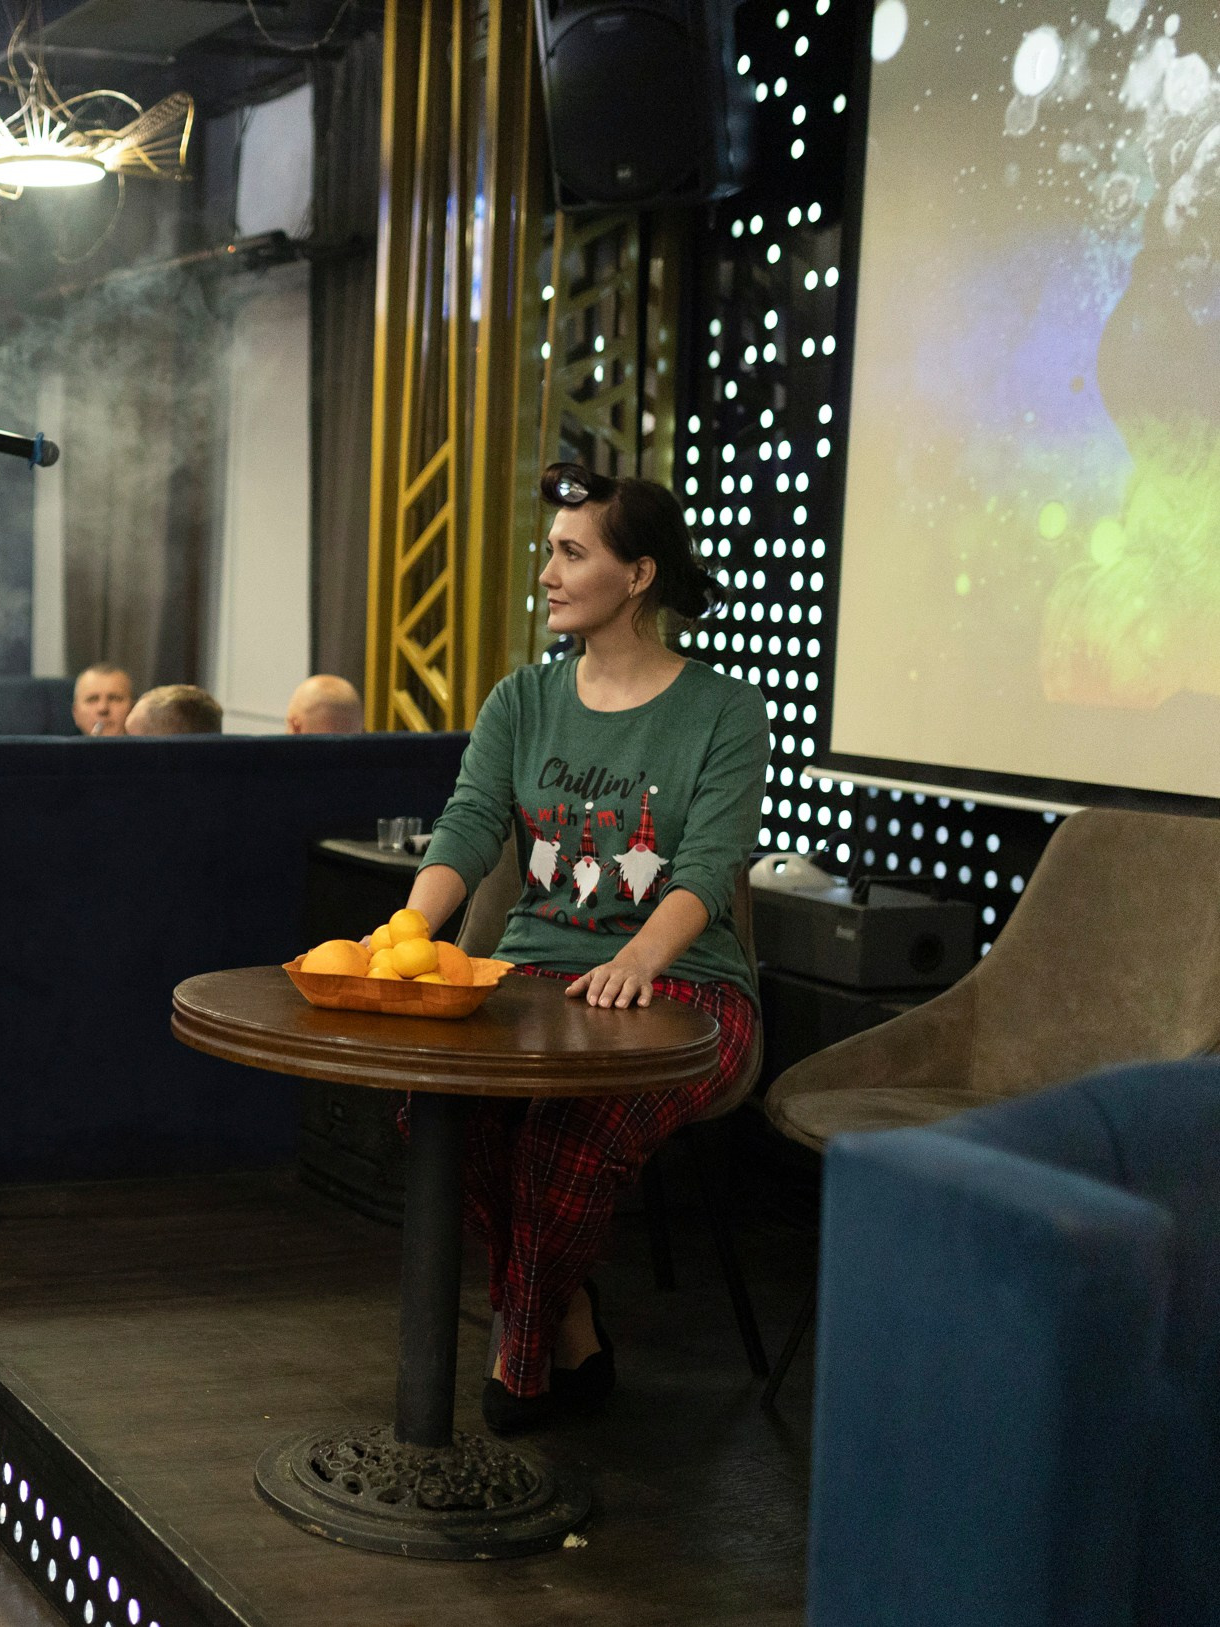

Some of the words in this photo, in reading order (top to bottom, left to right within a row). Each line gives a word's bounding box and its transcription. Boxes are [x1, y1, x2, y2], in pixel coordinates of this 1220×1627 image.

[537, 757, 646, 800] Chillin'
[538, 803, 578, 826] with
[597, 808, 624, 832] my
